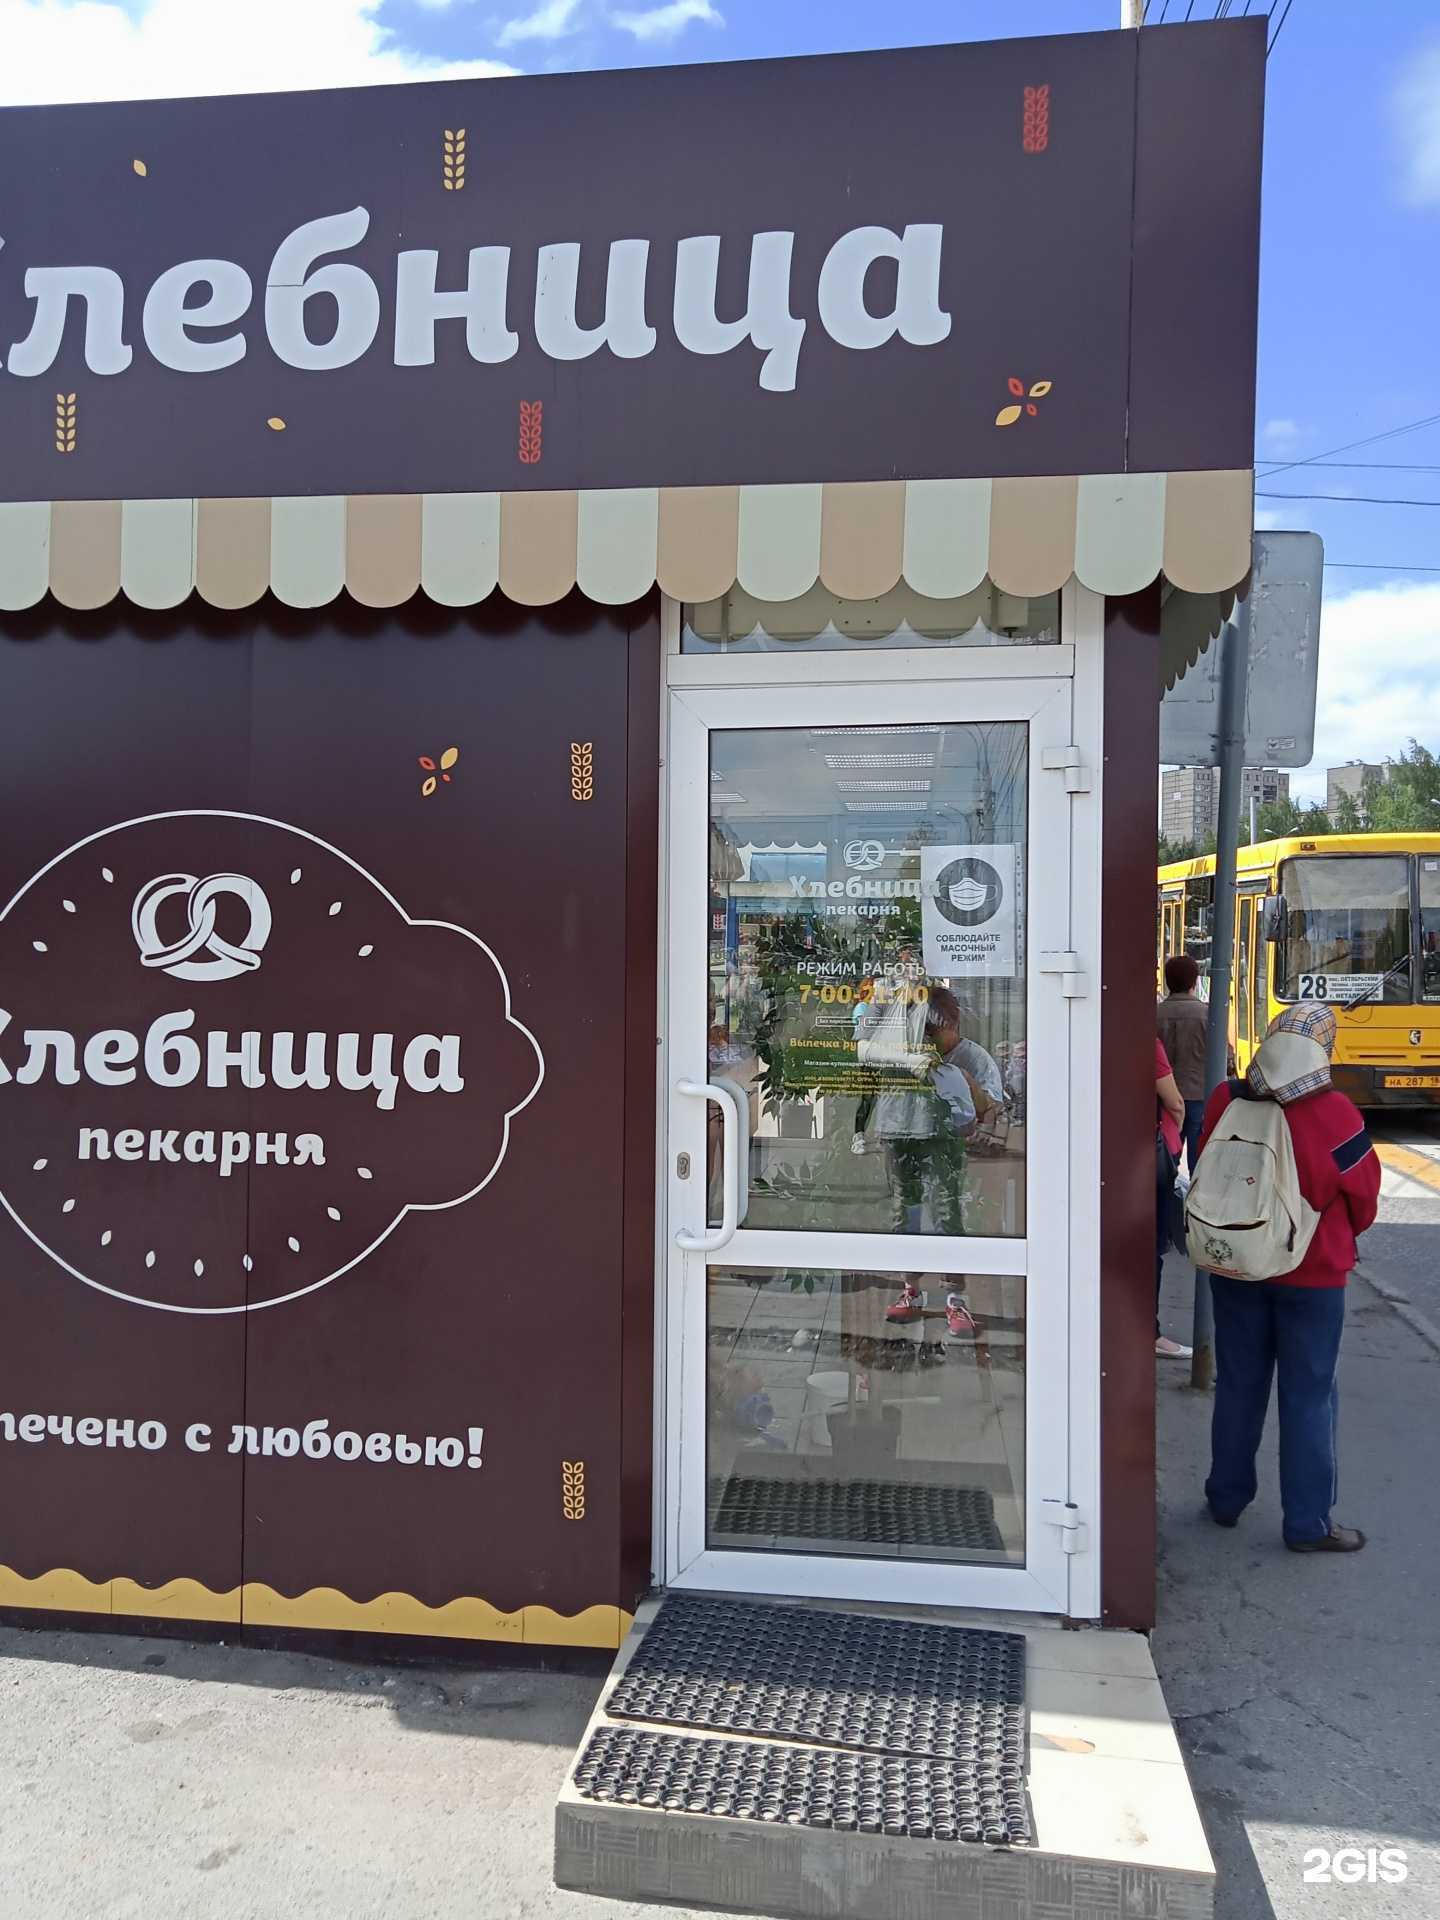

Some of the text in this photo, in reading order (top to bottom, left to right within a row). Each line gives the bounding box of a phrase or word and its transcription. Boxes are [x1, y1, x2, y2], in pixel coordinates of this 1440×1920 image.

[0, 206, 952, 392] лебница
[789, 875, 941, 903] Хлебница
[826, 904, 901, 919] пекарня
[935, 933, 1001, 944] СОБЛЮДАЙТЕ
[940, 943, 996, 952] МАСОЧНЫЙ
[951, 954, 985, 962] РЕЖИМ
[797, 962, 857, 976] РЕЖИМ
[1301, 975, 1328, 999] 28
[789, 1038, 840, 1048] Выпечка
[0, 1008, 465, 1110] лебница
[1406, 1077, 1424, 1087] 287
[78, 1127, 327, 1177] пекарня
[184, 1422, 213, 1452] с
[227, 1418, 485, 1469] любовью!
